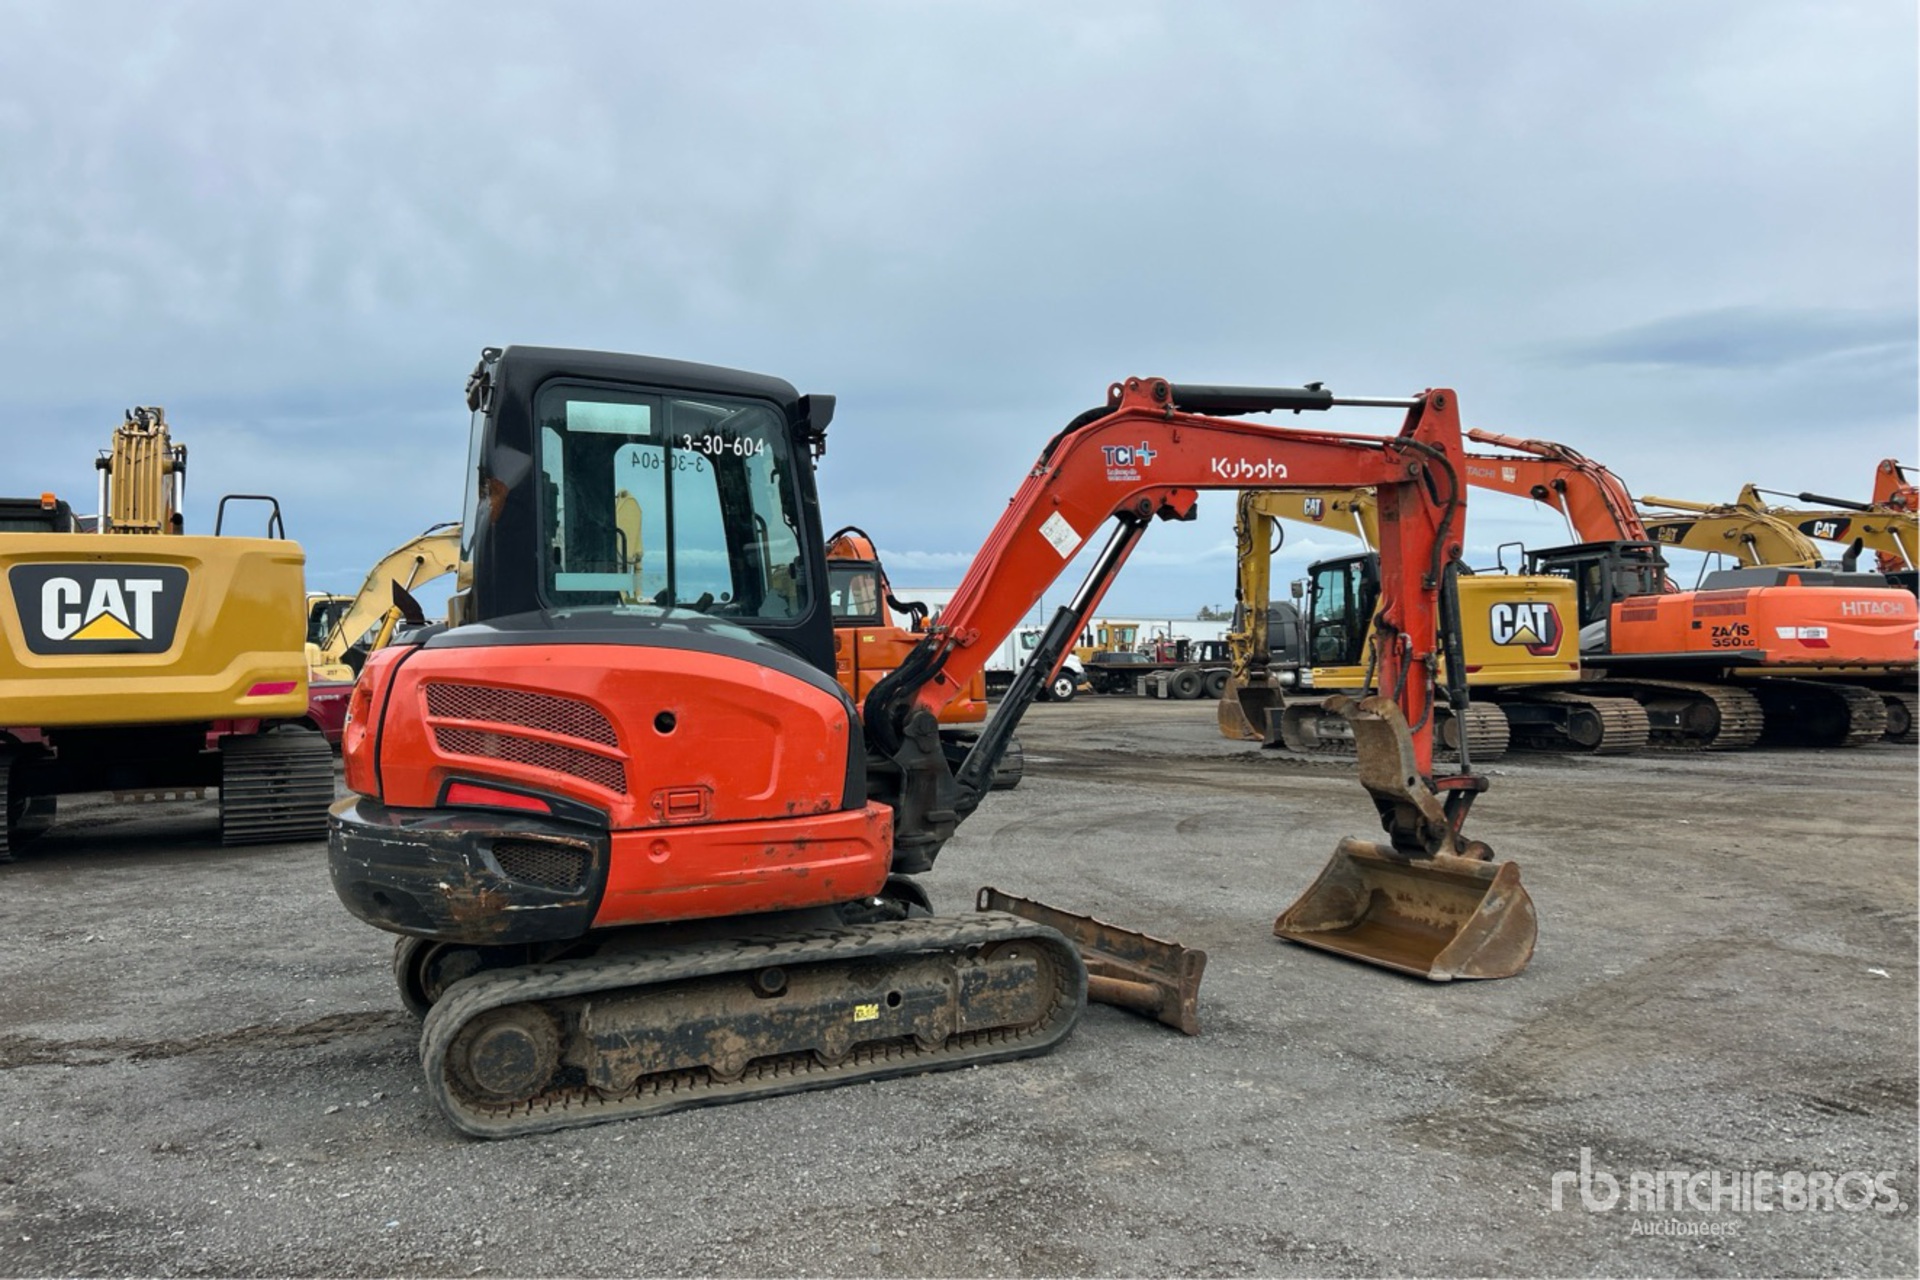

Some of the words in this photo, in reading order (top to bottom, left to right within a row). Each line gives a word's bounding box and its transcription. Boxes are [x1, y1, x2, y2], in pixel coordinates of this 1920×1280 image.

[682, 434, 764, 457] 3-30-604
[1211, 457, 1288, 479] Kubota
[1304, 498, 1321, 516] CAT
[1658, 526, 1678, 541] CAT
[1814, 521, 1838, 539] CAT
[41, 577, 163, 640] CAT
[1841, 601, 1904, 616] HITACHI
[1491, 604, 1549, 645] CAT
[1712, 637, 1742, 647] 350
